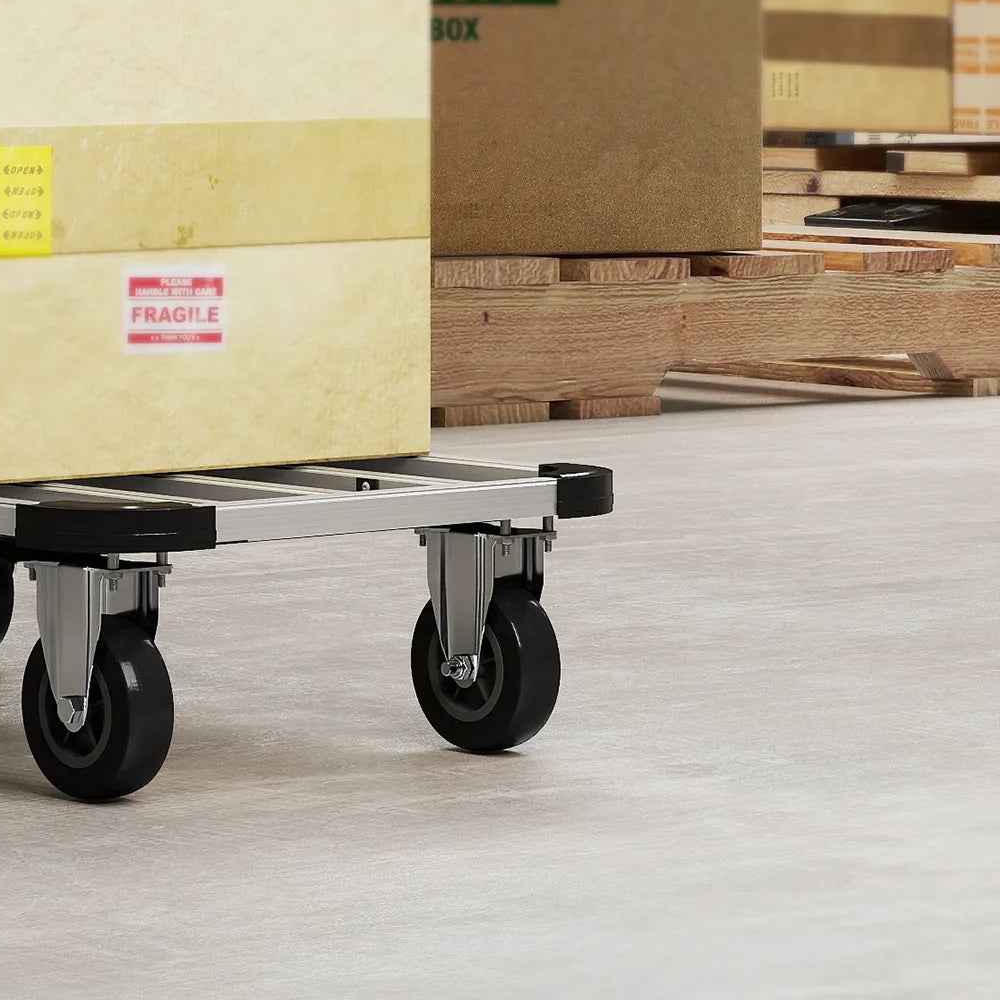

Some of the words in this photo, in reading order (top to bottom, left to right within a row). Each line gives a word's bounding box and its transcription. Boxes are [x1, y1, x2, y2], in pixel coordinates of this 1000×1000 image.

[431, 17, 481, 42] BOX
[10, 166, 36, 175] OPEN
[9, 210, 34, 219] OPEN
[131, 305, 220, 324] FRAGILE
